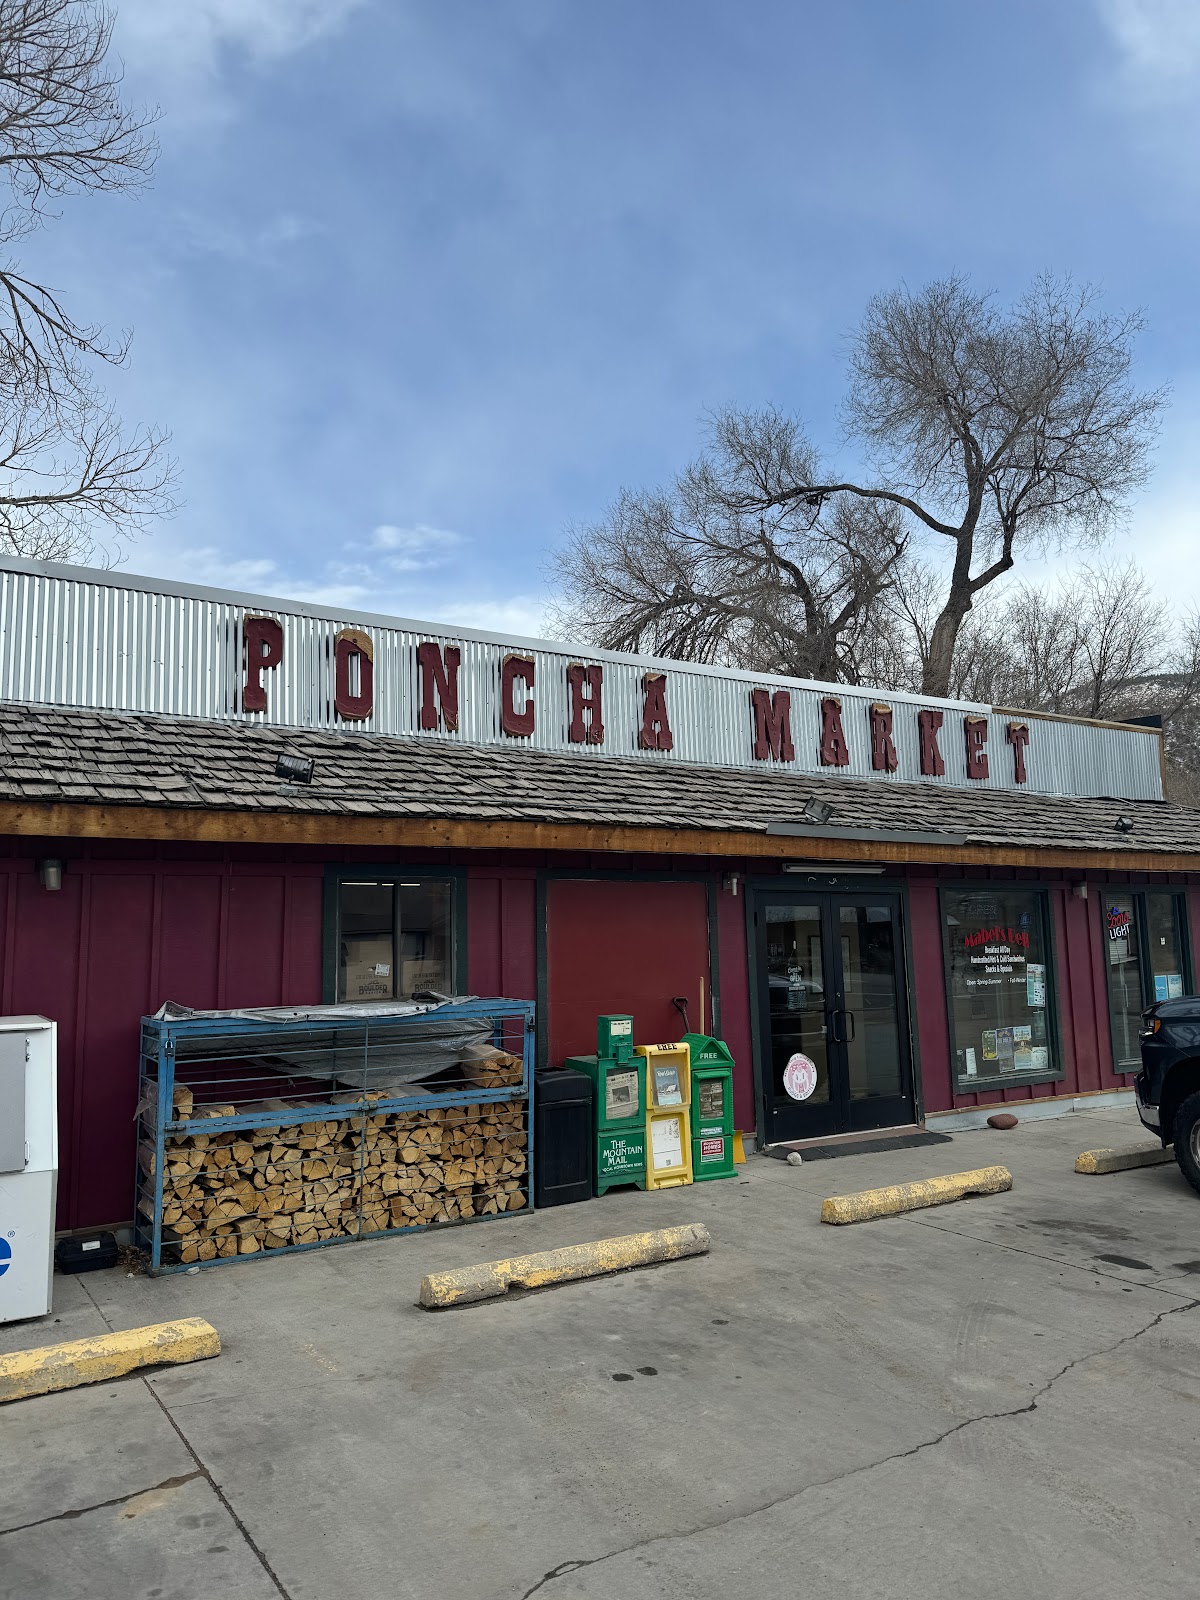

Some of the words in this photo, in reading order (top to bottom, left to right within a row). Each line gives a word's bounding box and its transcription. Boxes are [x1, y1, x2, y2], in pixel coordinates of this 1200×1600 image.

[242, 613, 674, 751] PONCHA
[752, 687, 1029, 784] MARKET
[964, 926, 1007, 948] Mabel's
[1007, 927, 1030, 949] Deli
[1109, 923, 1131, 940] LIGHT
[358, 984, 388, 996] BOULDER
[414, 984, 442, 992] BOULDER
[610, 1140, 626, 1150] THE
[602, 1146, 642, 1158] MOUNTAIN
[607, 1156, 628, 1166] MAIL
